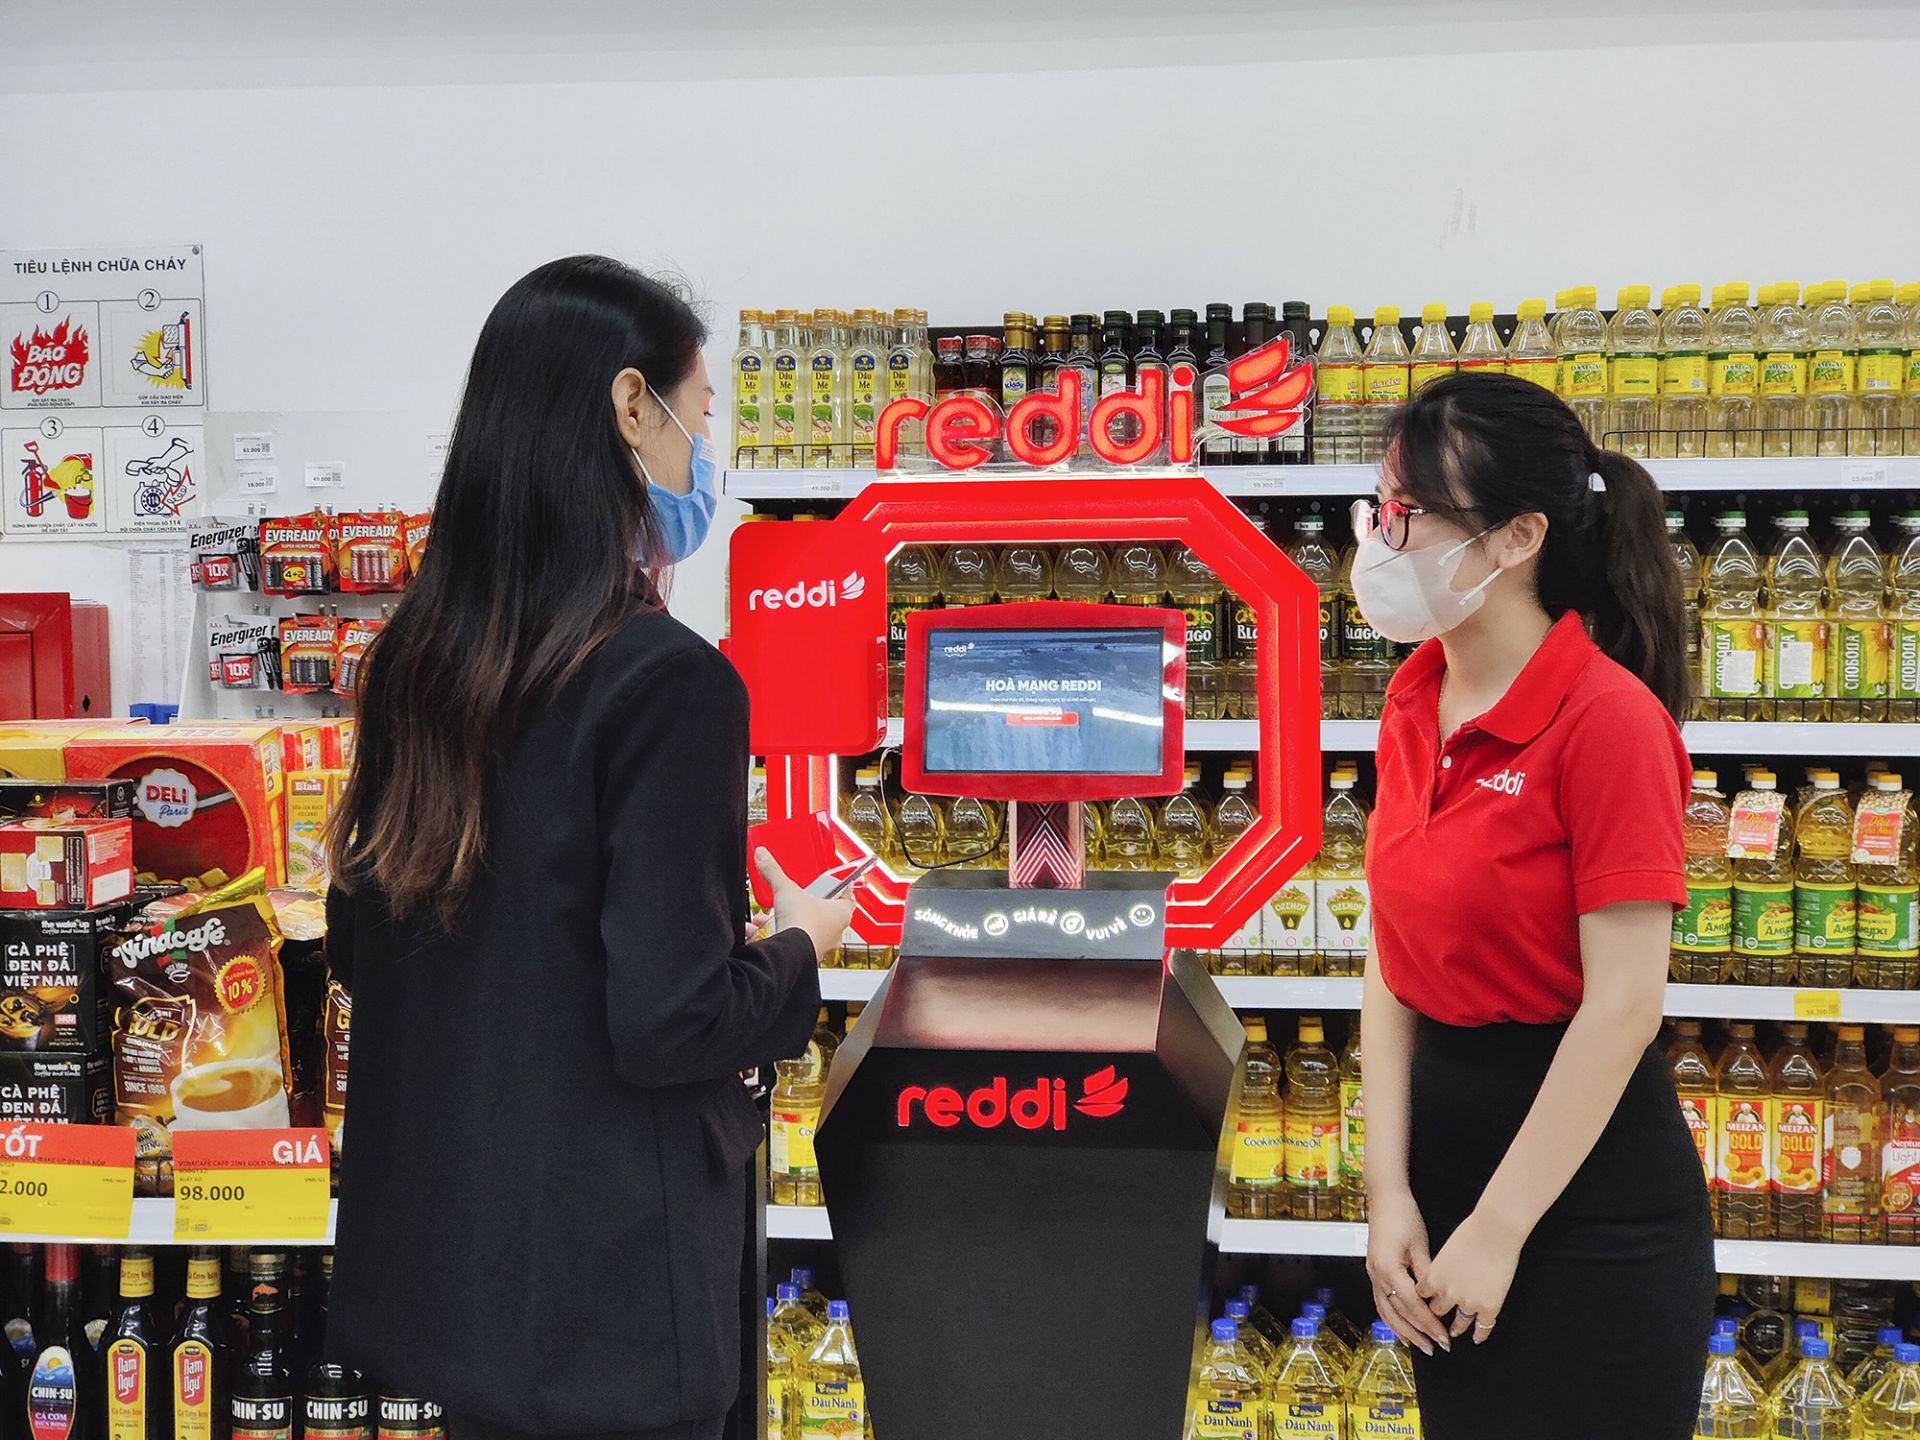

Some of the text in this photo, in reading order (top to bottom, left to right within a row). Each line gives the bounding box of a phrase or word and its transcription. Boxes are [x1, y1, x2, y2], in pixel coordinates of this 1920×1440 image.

[14, 257, 187, 276] TIÊU LỆNH CHỮA CHÁY
[44, 295, 51, 310] 1
[145, 292, 155, 308] 2
[147, 418, 159, 434] 4
[876, 367, 1194, 471] reddi
[48, 420, 57, 436] 3
[190, 525, 246, 548] Energizer
[265, 530, 323, 542] EVEREADY
[342, 526, 398, 538] EVEREADY
[749, 580, 836, 611] reddi
[210, 625, 268, 647] Energizer
[284, 629, 335, 642] EVEREADY
[944, 644, 967, 653] reddi
[985, 677, 1102, 695] HOÀ MẠNG REDDI
[146, 784, 188, 803] DELI
[159, 805, 189, 819] Paris
[1086, 928, 1111, 940] VUI
[8, 942, 69, 956] CÀ PHÊ
[9, 957, 70, 972] ĐEN ĐÁ
[3, 973, 78, 990] VIỆT NAM
[1, 1084, 60, 1099] CÀ PHÊ
[2, 1099, 62, 1114] ĐEN ĐÁ
[897, 1076, 1066, 1131] reddi
[1727, 1122, 1766, 1132] MEIZAN
[1779, 1125, 1818, 1134] MEIZAN
[272, 1134, 323, 1163] GIÁ
[1730, 1133, 1762, 1150] GOLD
[1782, 1135, 1814, 1152] GOLD
[180, 1186, 245, 1201] 98.000
[118, 1357, 137, 1373] Nam
[184, 1358, 203, 1374] Nam
[32, 1386, 73, 1400] CHIN-SU
[306, 1400, 368, 1420] CHIN-SU
[381, 1402, 443, 1420] CHIN-SU
